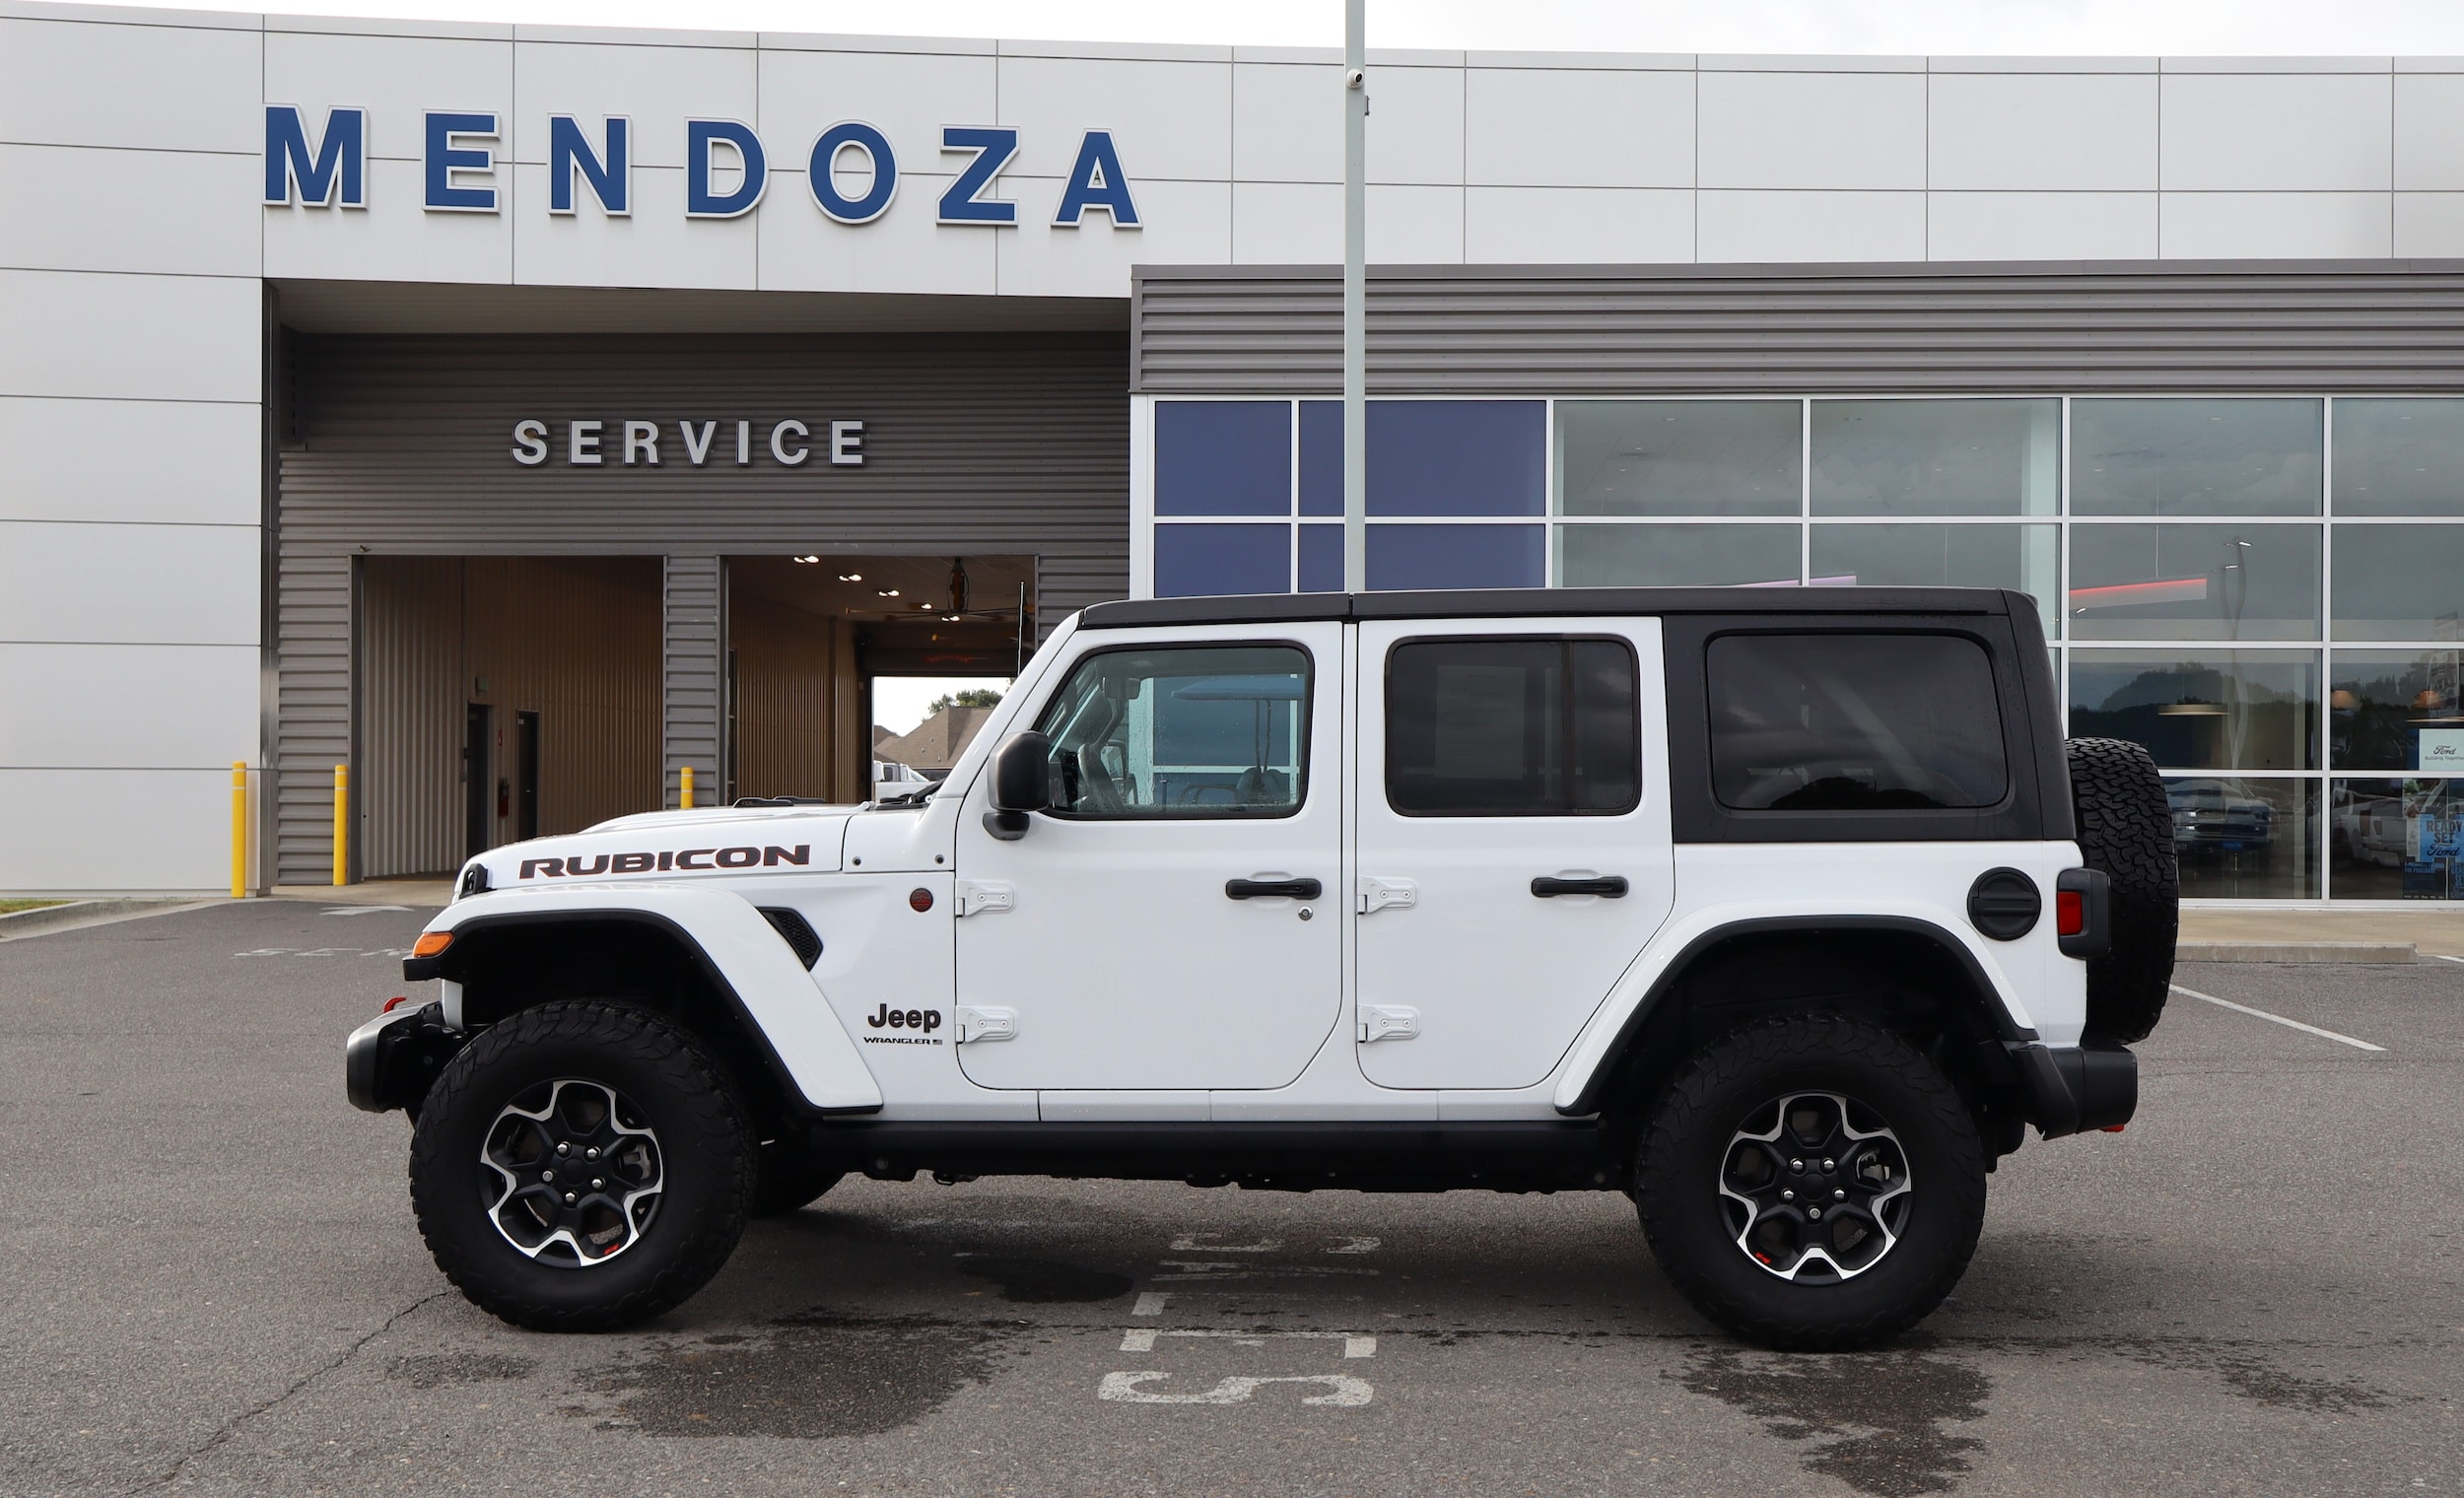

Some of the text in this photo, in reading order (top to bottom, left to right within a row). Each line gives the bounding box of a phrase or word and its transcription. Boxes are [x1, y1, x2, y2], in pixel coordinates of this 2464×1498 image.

[262, 102, 1143, 229] MENDOZA
[511, 418, 865, 466] SERVICE
[2432, 745, 2457, 755] Ford
[2427, 820, 2462, 832] READY
[2433, 832, 2455, 843] SET
[2427, 843, 2461, 856] Ford
[518, 845, 811, 879] RUBICON
[867, 1003, 941, 1034] Jeep
[862, 1037, 931, 1046] WRANGLER
